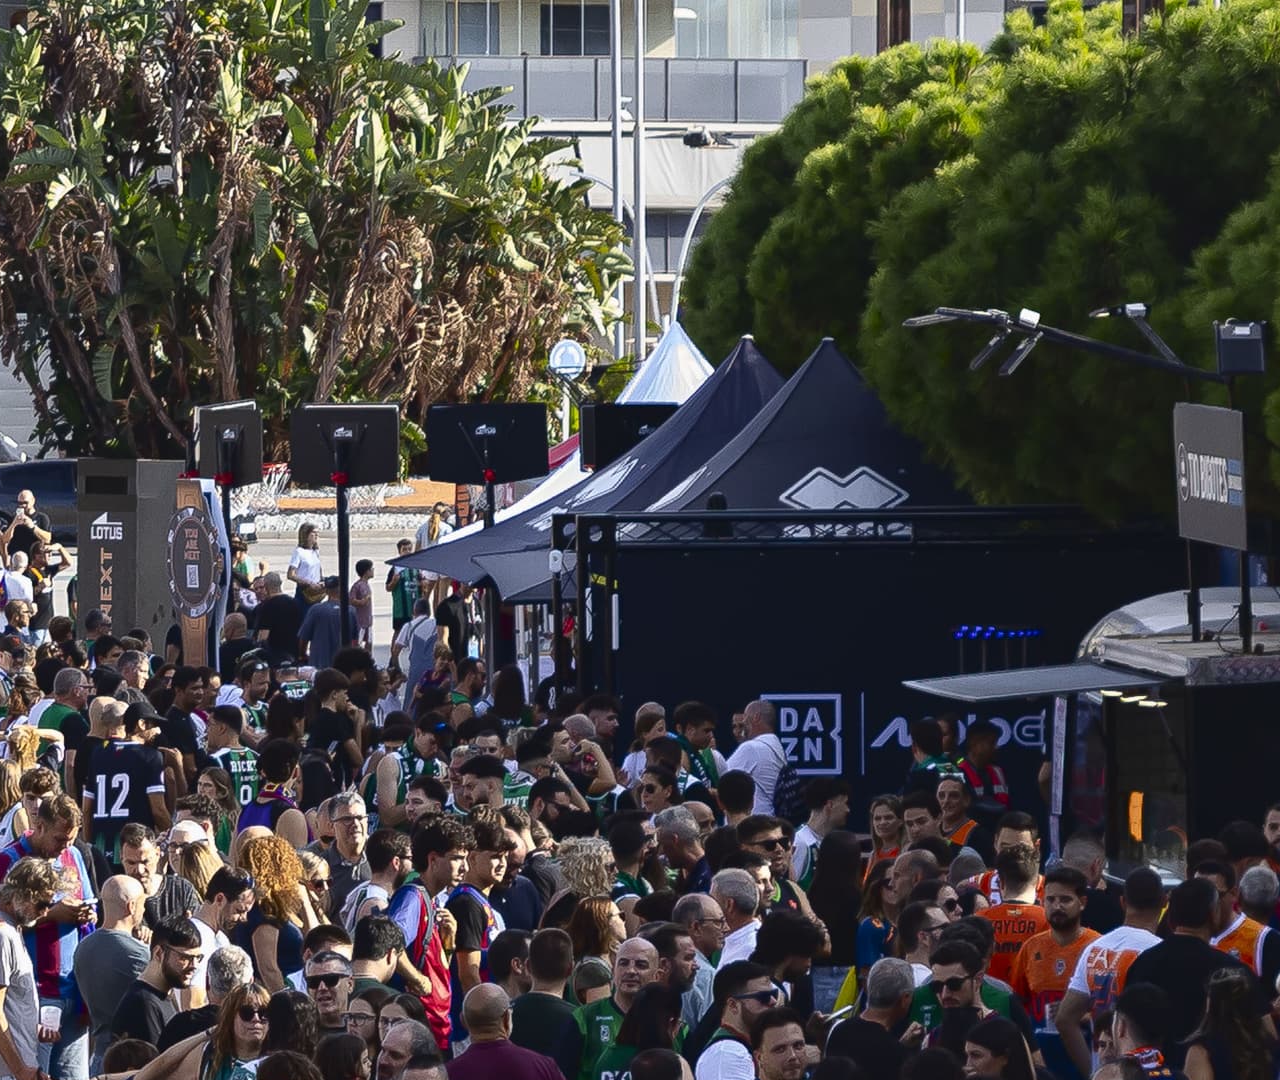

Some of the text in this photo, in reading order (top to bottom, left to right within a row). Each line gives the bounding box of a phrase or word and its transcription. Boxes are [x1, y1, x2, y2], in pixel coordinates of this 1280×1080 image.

[91, 526, 122, 540] LOTUS
[94, 773, 130, 818] 12
[240, 784, 252, 805] 0
